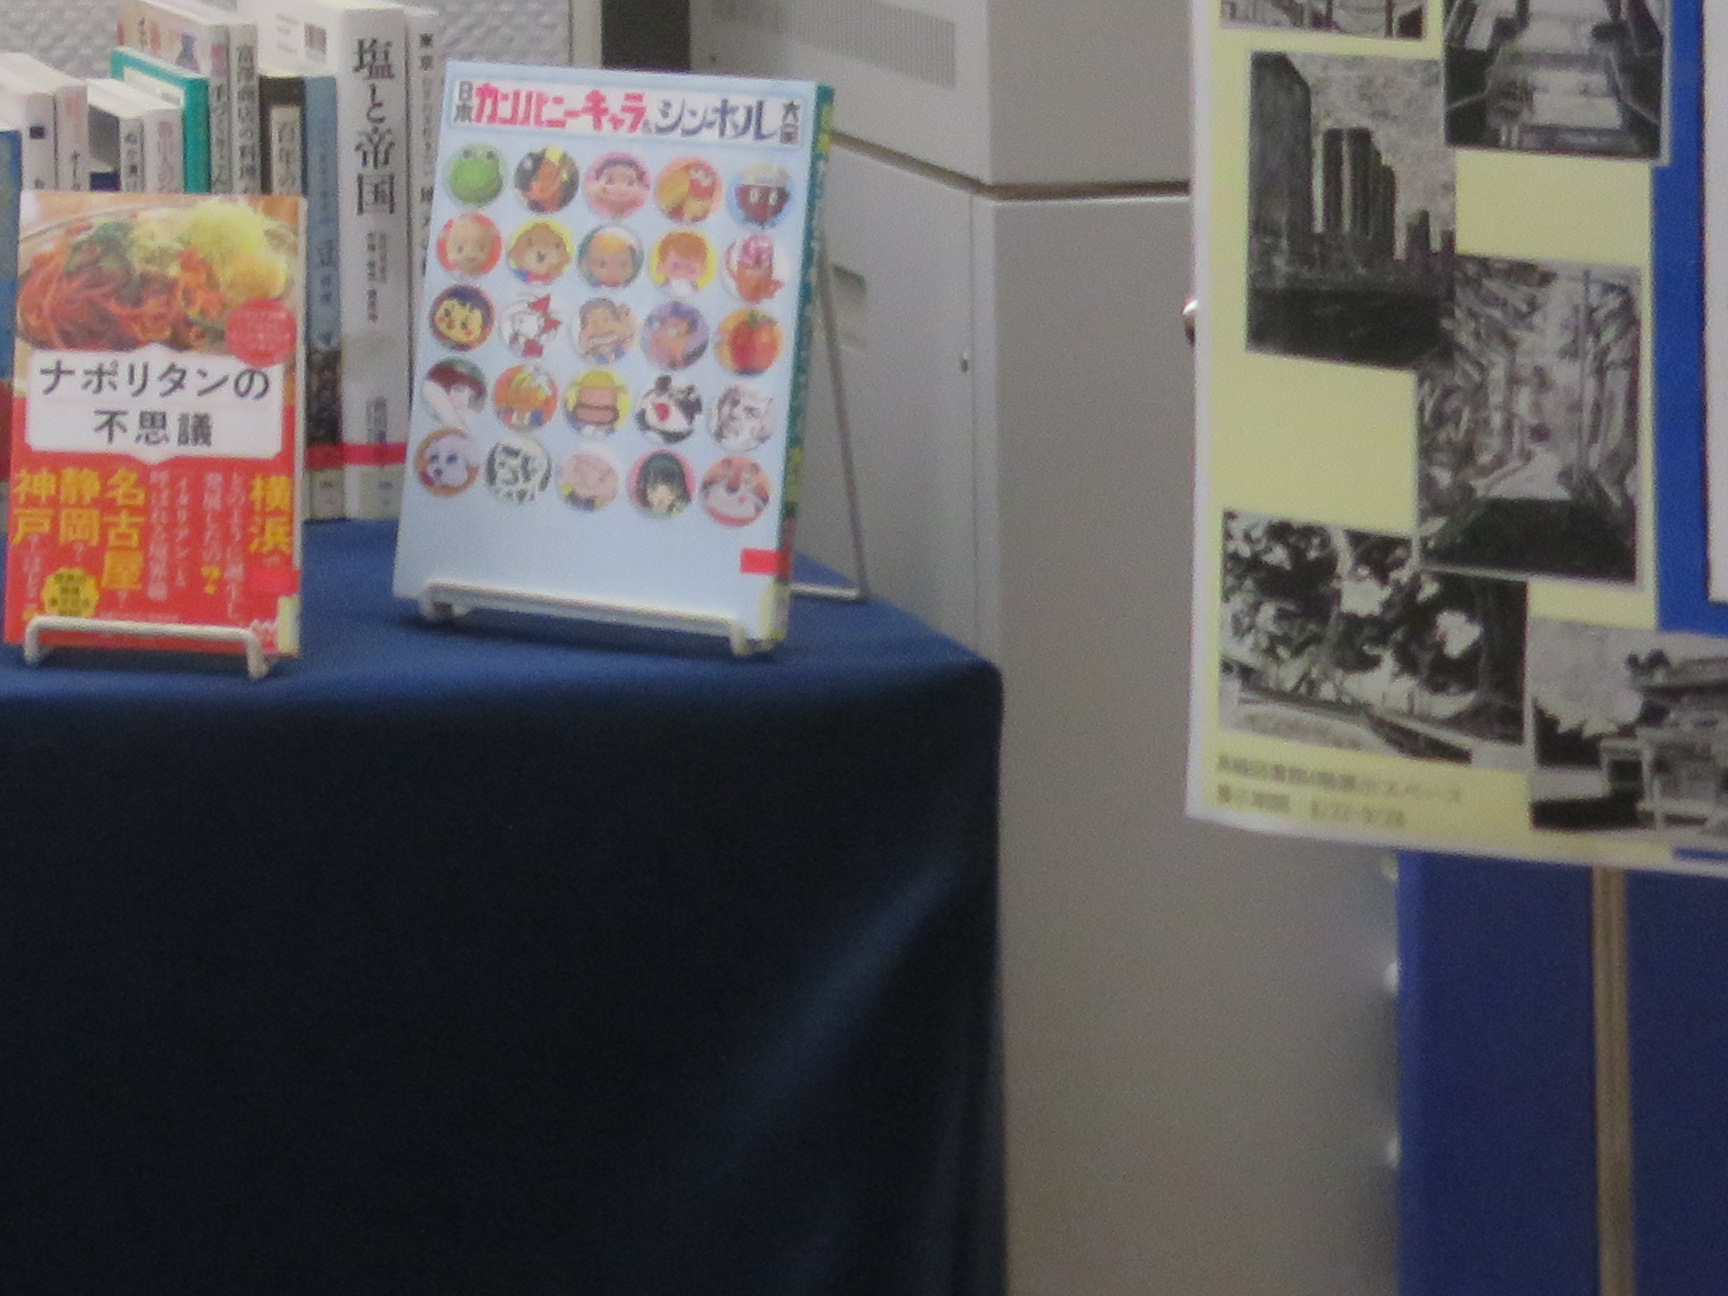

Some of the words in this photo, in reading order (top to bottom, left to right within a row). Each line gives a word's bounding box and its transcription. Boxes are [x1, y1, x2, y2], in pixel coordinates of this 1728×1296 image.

[353, 37, 396, 216] 塩と帝国
[656, 97, 779, 141] シンボル
[39, 360, 270, 401] ナポリタンの
[93, 409, 213, 447] 不思議
[249, 474, 294, 556] 横浜
